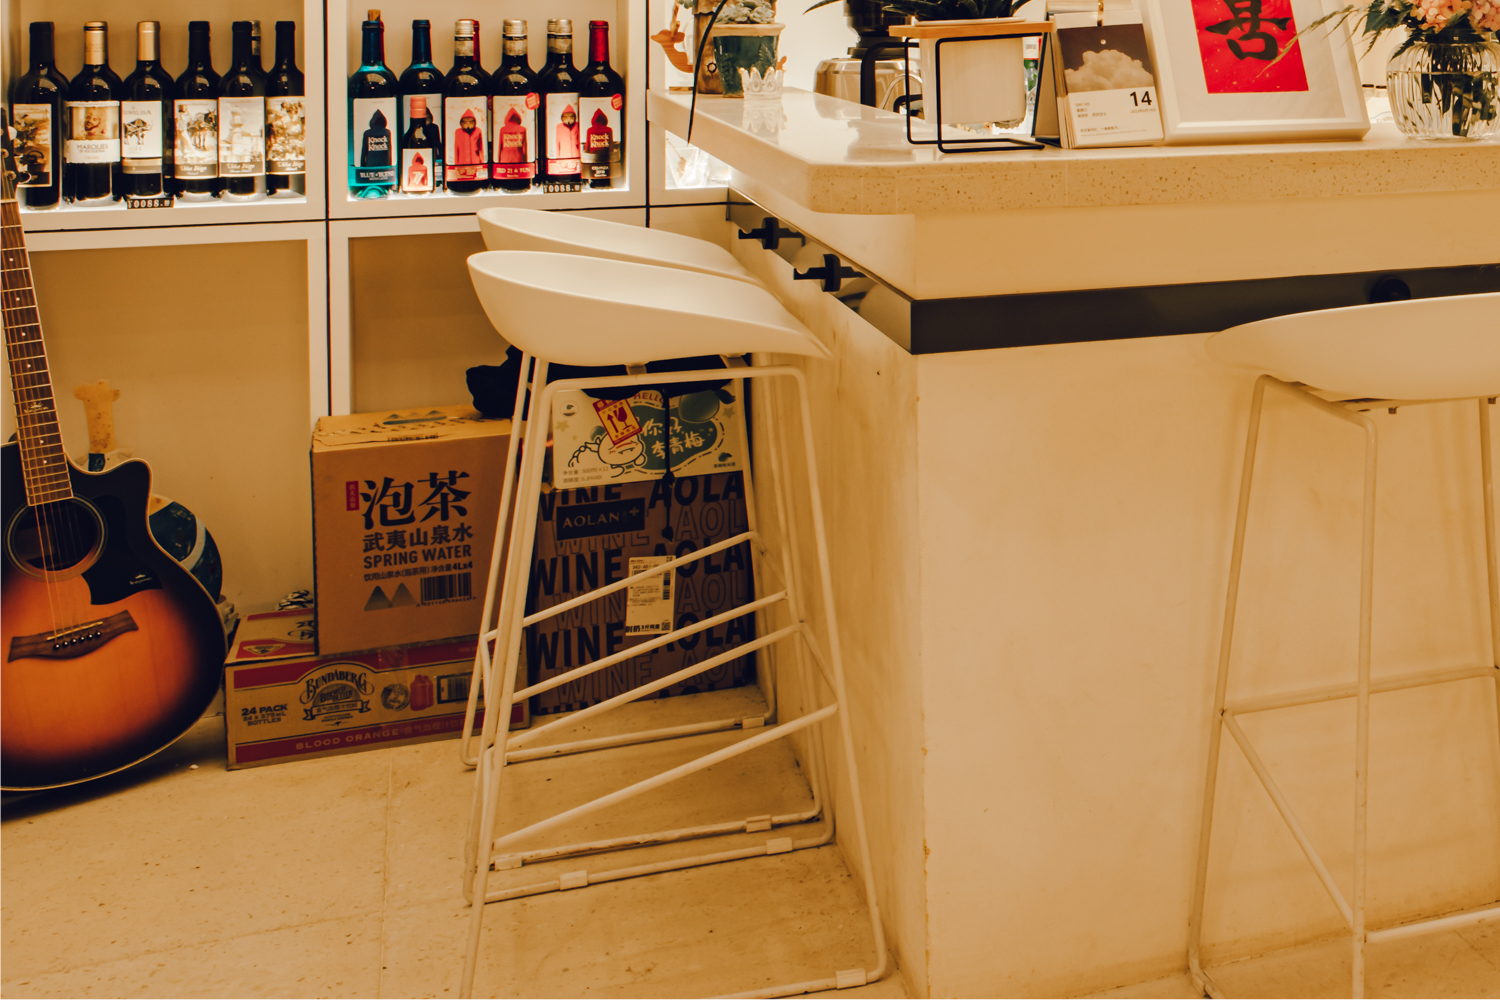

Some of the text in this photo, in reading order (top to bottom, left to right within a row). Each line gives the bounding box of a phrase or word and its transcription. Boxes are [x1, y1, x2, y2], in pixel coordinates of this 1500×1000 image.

[1129, 90, 1152, 107] 14
[367, 135, 389, 144] Knock
[503, 133, 523, 141] Knock
[590, 133, 610, 141] Knock
[367, 143, 389, 152] Knock
[503, 140, 523, 148] Knock
[590, 140, 610, 148] Knock
[360, 470, 471, 530] 泡茶
[562, 513, 620, 529] AOLAN
[363, 522, 473, 553] 武夷山泉水
[364, 544, 472, 569] SPRING WATER
[300, 668, 375, 704] BUNDABERG
[241, 703, 288, 716] 24 PACK
[247, 716, 282, 727] BOTTLES
[295, 737, 341, 751] BLOOD
[345, 728, 399, 743] ORANGE
